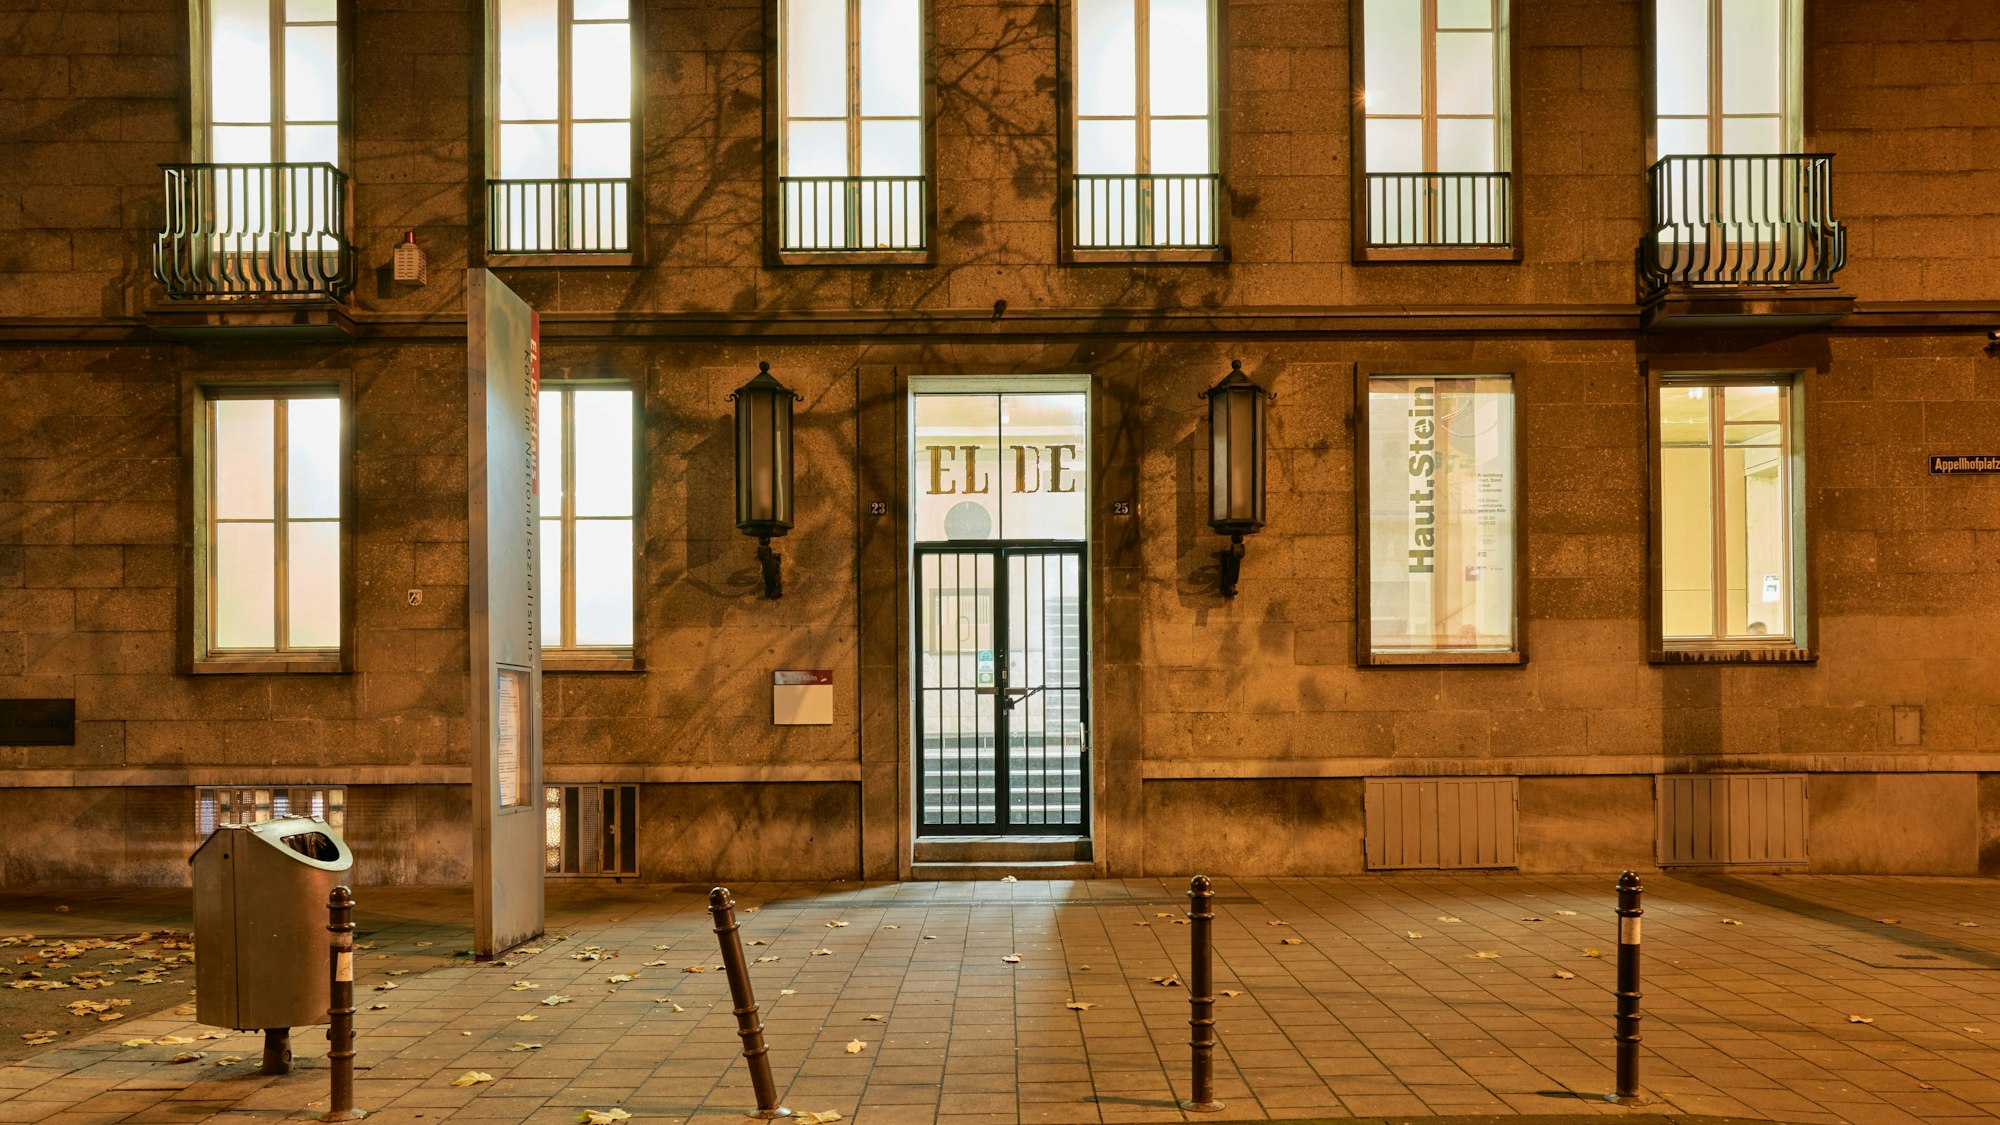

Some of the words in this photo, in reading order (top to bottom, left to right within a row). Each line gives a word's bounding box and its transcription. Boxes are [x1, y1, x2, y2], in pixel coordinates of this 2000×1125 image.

[925, 445, 989, 495] EL
[1009, 444, 1076, 493] DE
[1935, 457, 2000, 473] Appellhofplatz
[871, 502, 886, 514] 23
[1114, 502, 1129, 514] 25
[525, 442, 534, 663] Nationalsozialismus
